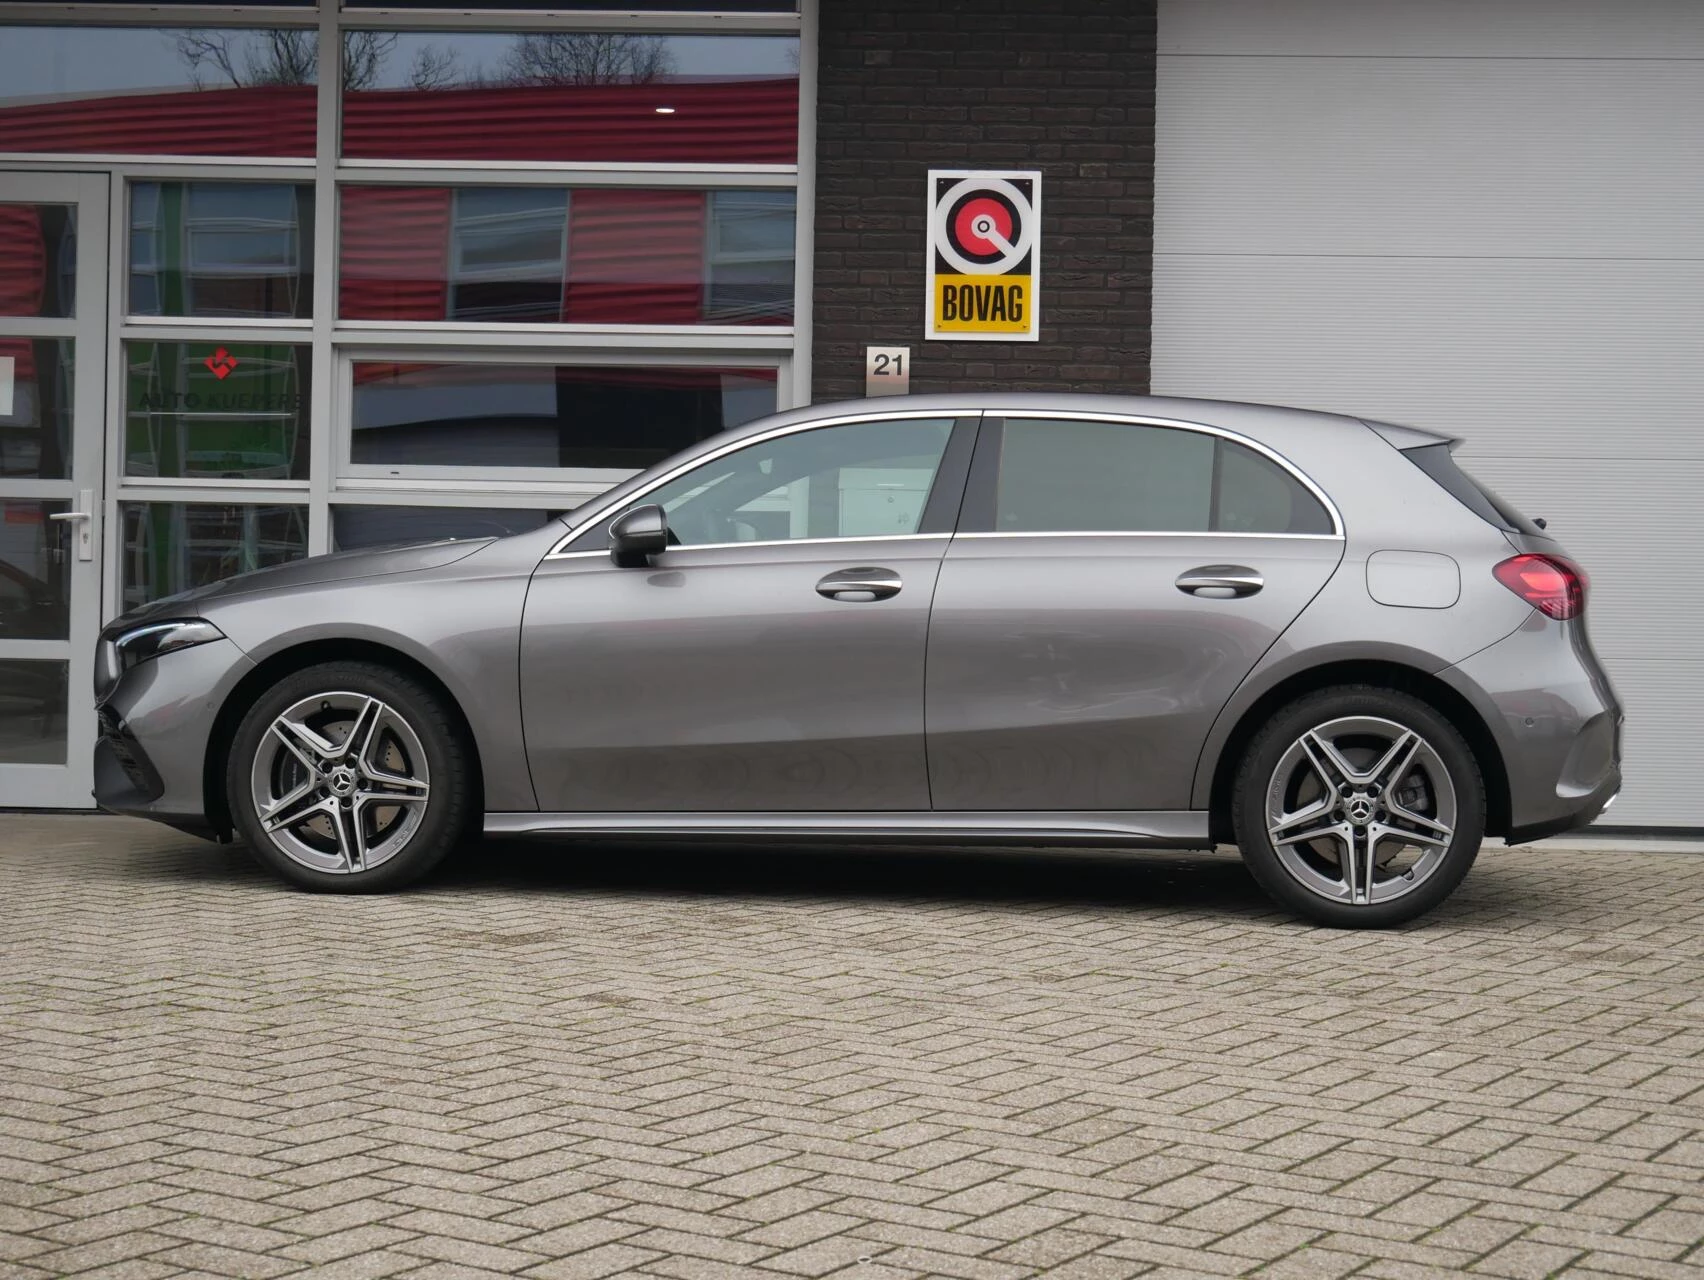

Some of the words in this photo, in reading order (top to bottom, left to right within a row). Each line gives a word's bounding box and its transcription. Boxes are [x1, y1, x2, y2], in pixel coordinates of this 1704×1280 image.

[942, 284, 1023, 322] BOVAG
[873, 354, 903, 376] 21
[139, 392, 200, 408] AUTO
